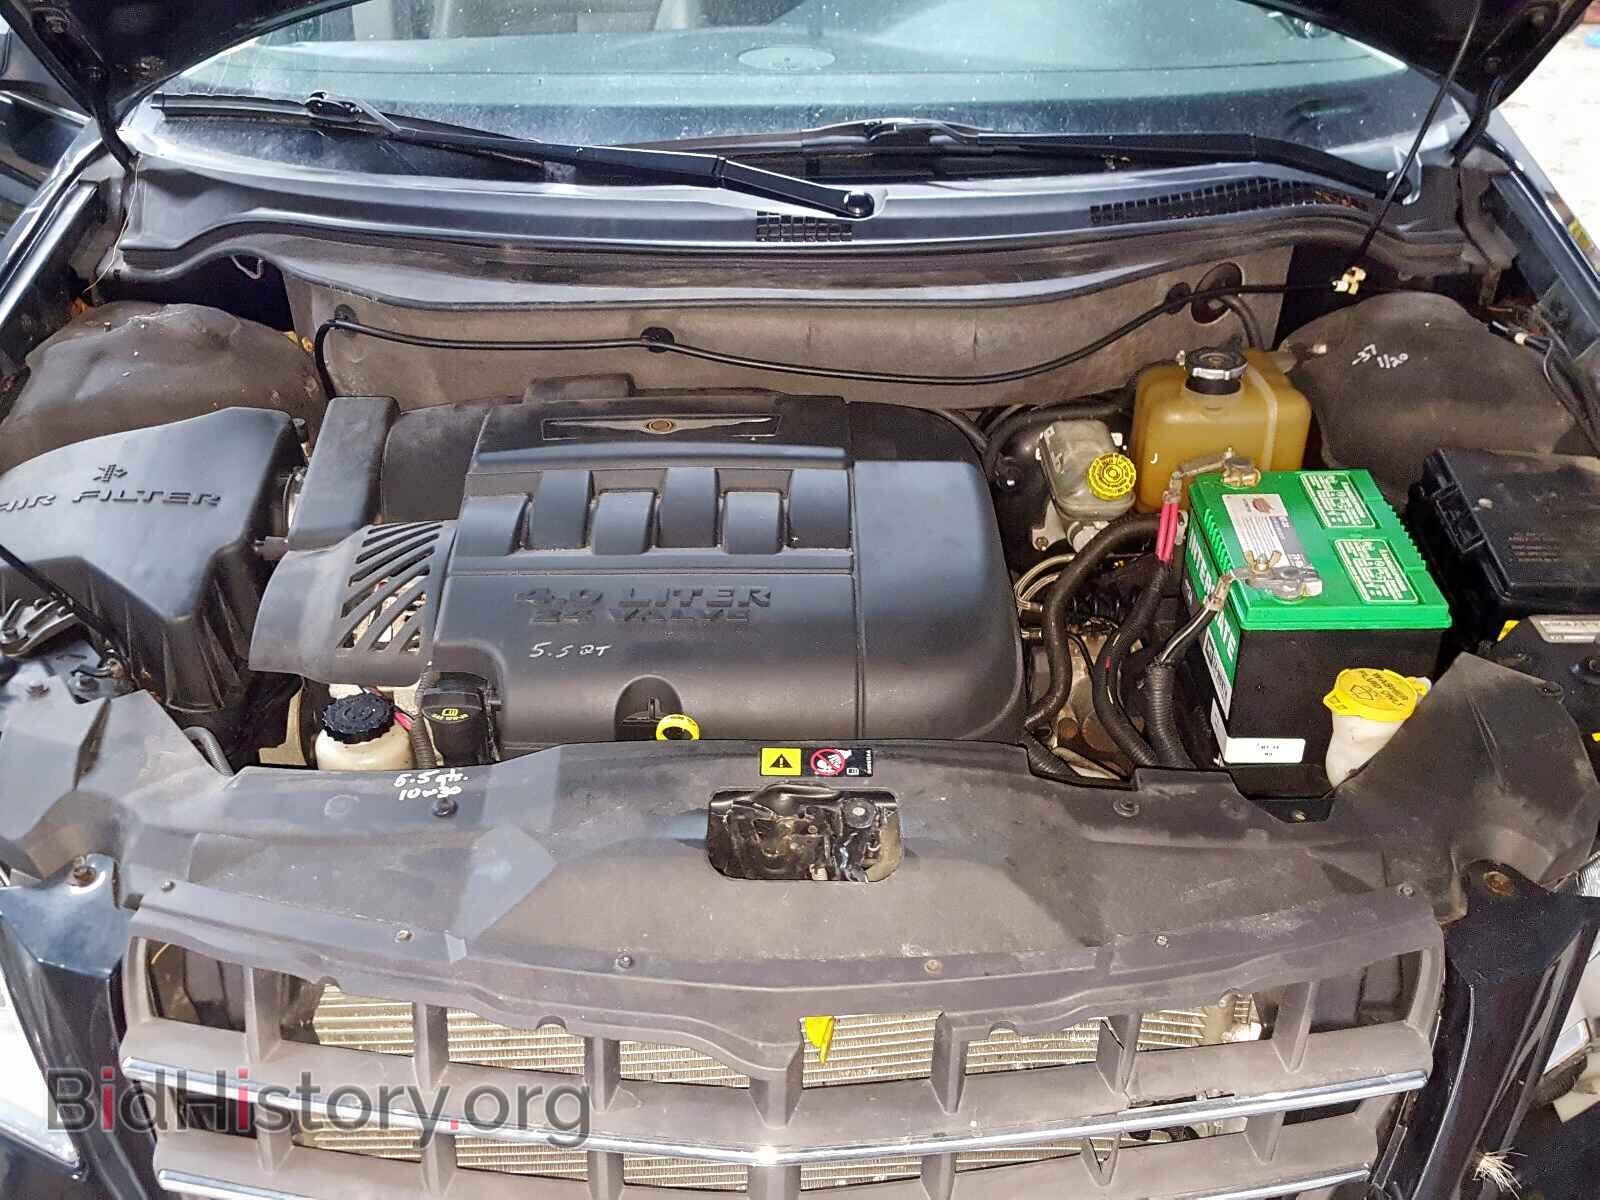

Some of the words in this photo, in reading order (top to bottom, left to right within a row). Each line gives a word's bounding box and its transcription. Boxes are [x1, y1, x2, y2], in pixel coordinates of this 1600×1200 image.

[72, 489, 221, 507] FILTER
[619, 586, 772, 608] LITER
[1188, 527, 1237, 662] INTERATE
[528, 641, 574, 659] 5.5
